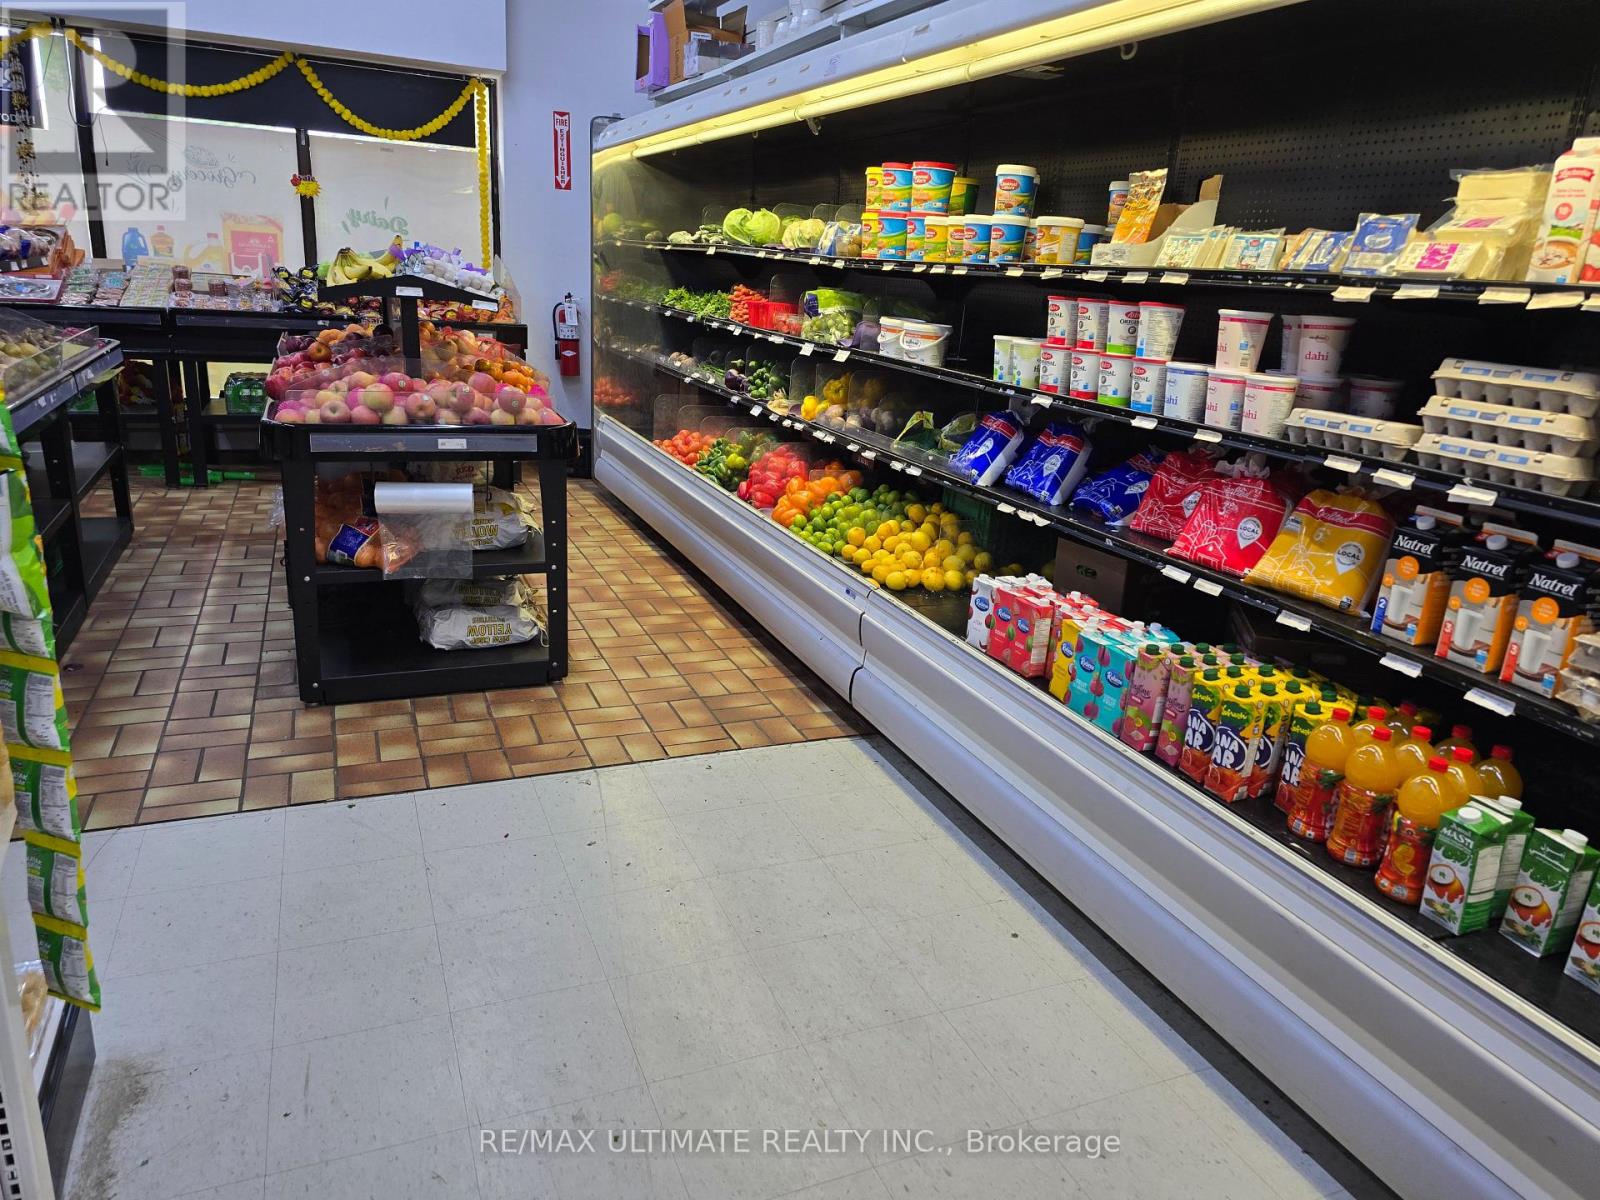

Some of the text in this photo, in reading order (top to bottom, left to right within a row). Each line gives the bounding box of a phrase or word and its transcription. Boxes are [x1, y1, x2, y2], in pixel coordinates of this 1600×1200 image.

[1305, 351, 1329, 361] dahi
[1165, 395, 1178, 405] ahi
[1240, 526, 1259, 535] LOCAL
[1394, 534, 1435, 554] Natrel
[1338, 551, 1360, 561] LOCAL
[1461, 555, 1507, 576] Natrel
[1528, 573, 1578, 596] Natrel
[1379, 599, 1386, 609] 2
[467, 623, 512, 637] YELLOW
[1444, 621, 1452, 633] 3
[1510, 643, 1518, 656] 3
